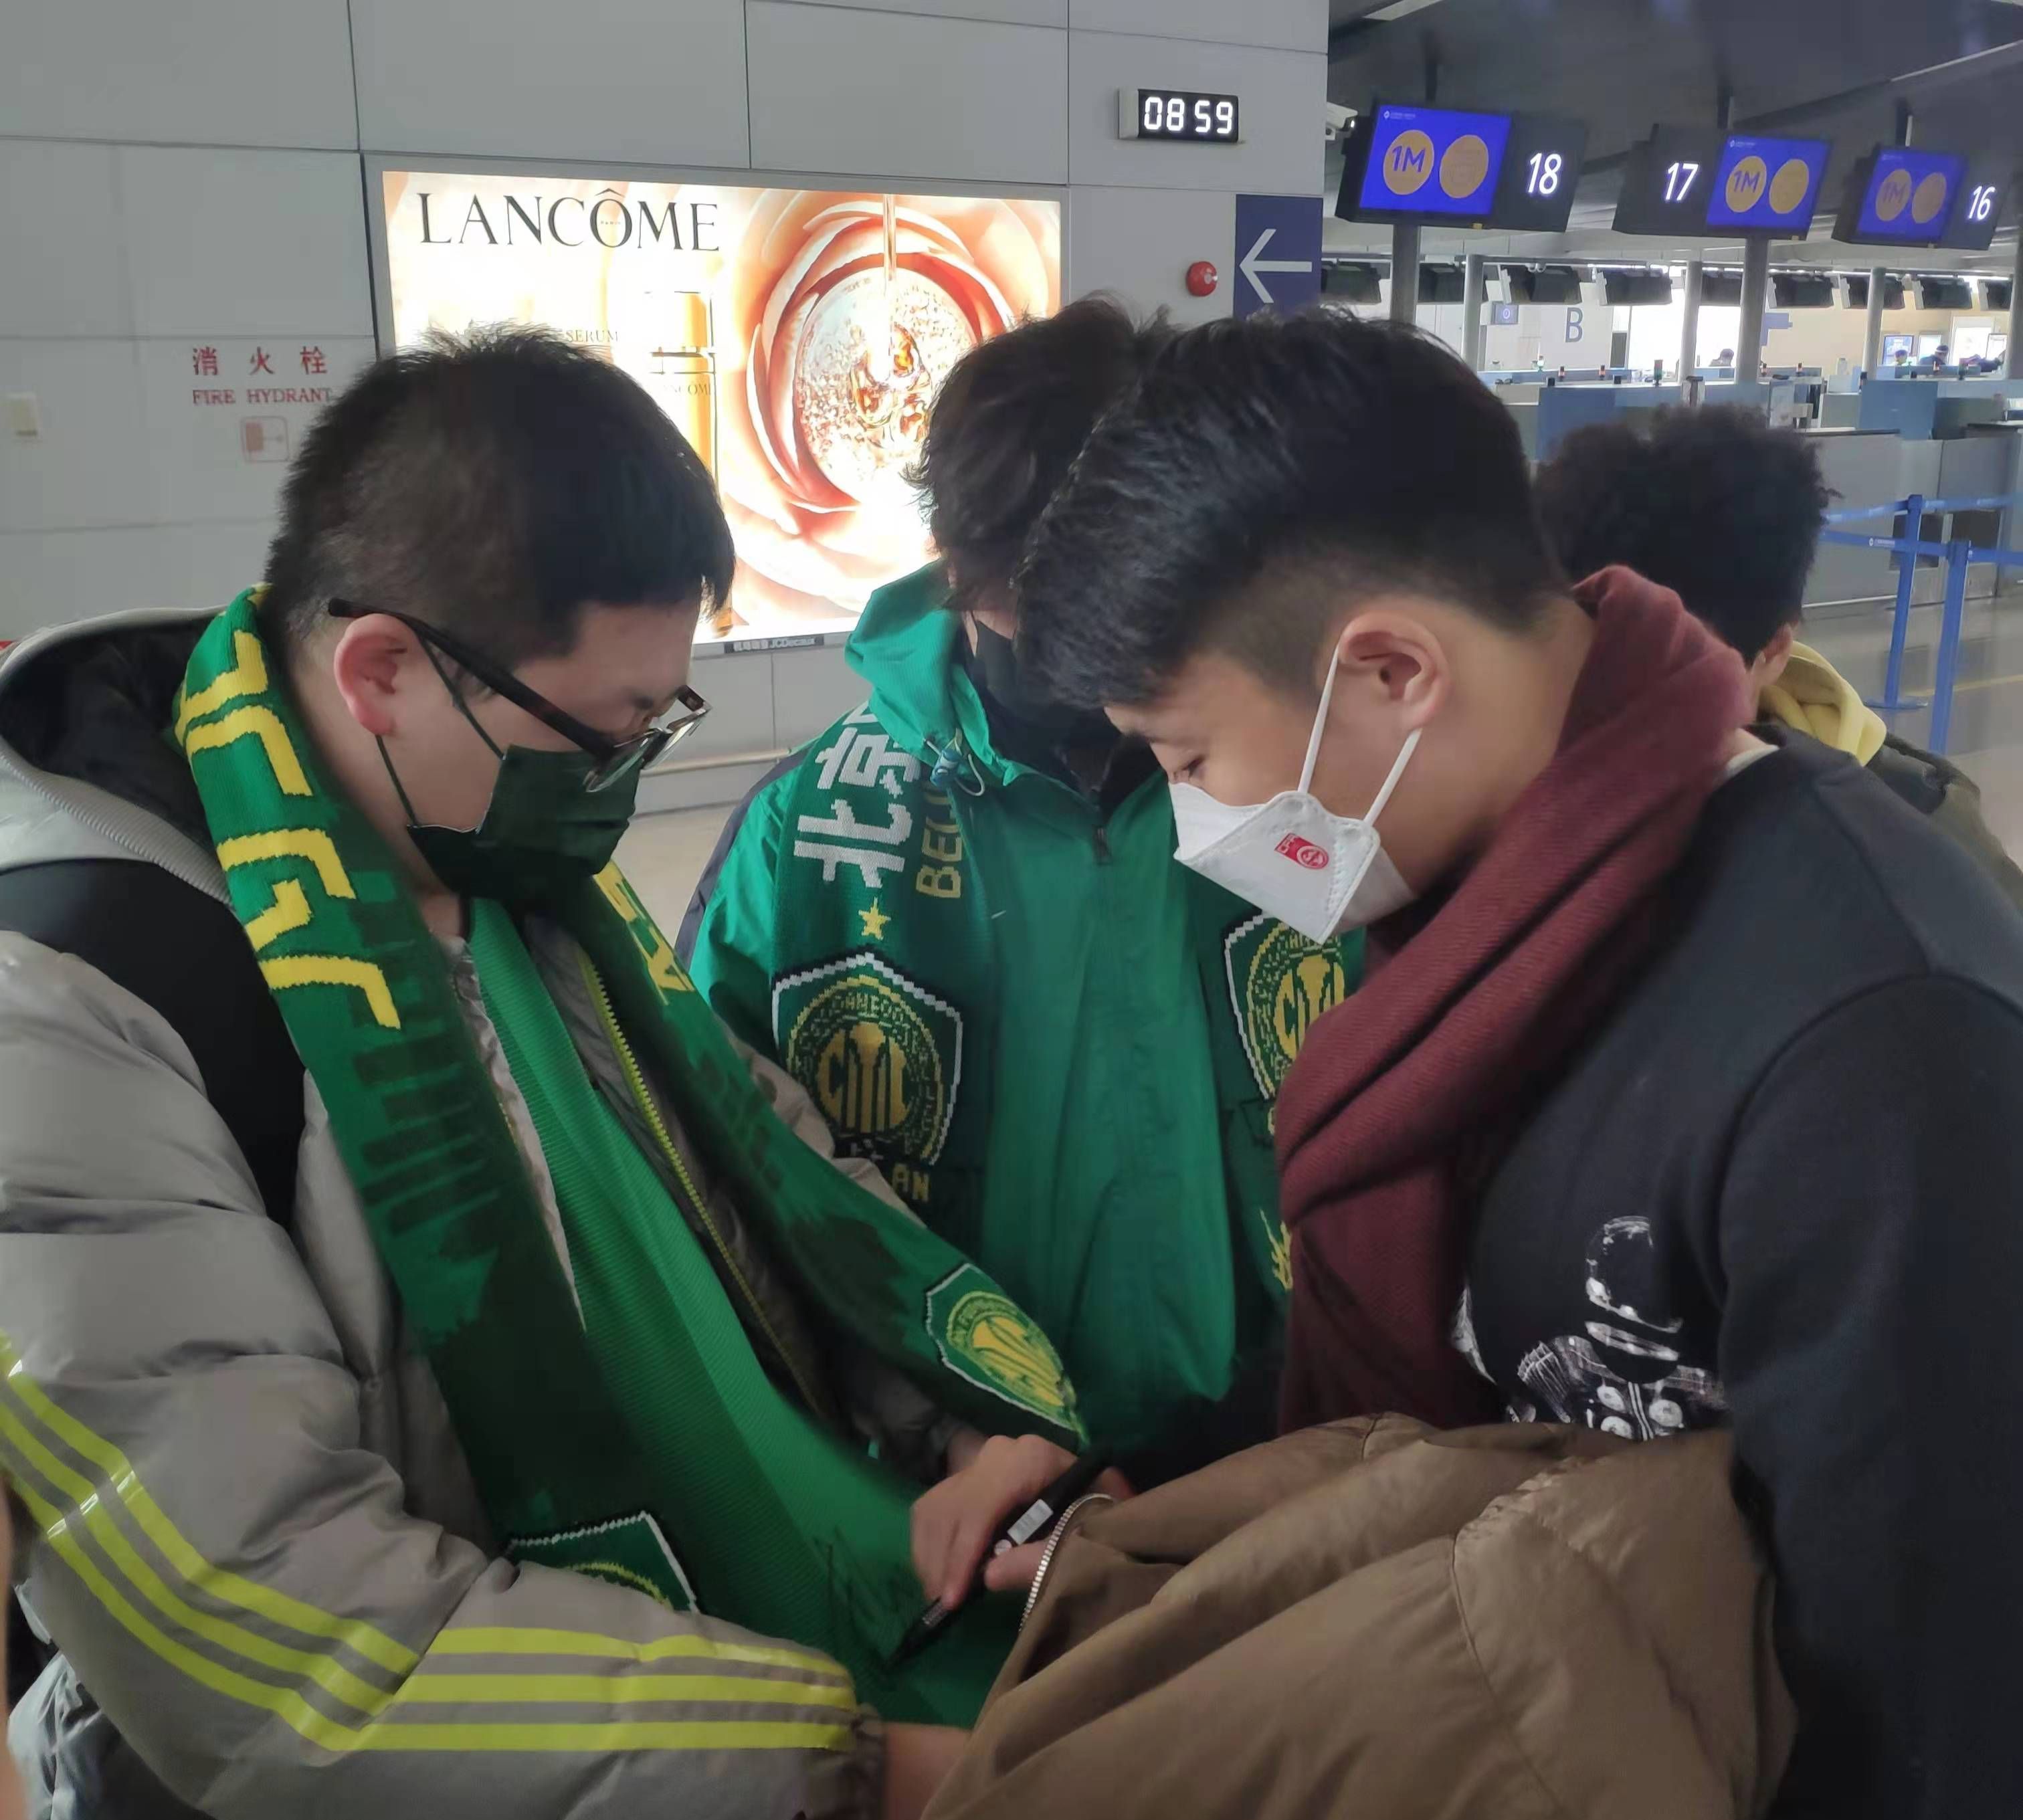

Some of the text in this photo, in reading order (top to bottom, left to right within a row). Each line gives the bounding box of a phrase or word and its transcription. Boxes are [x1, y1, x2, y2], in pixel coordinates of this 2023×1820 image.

[1391, 144, 1426, 173] 1M
[1527, 152, 1562, 195] 18
[1665, 162, 1699, 201] 17
[416, 187, 720, 251] LANCÔME
[1967, 186, 1996, 220] 16
[566, 330, 618, 343] SERUM
[1565, 307, 1583, 343] B
[192, 346, 328, 376] 消火栓
[192, 388, 332, 405] FIRE HYDRANT
[793, 725, 921, 889] 北京
